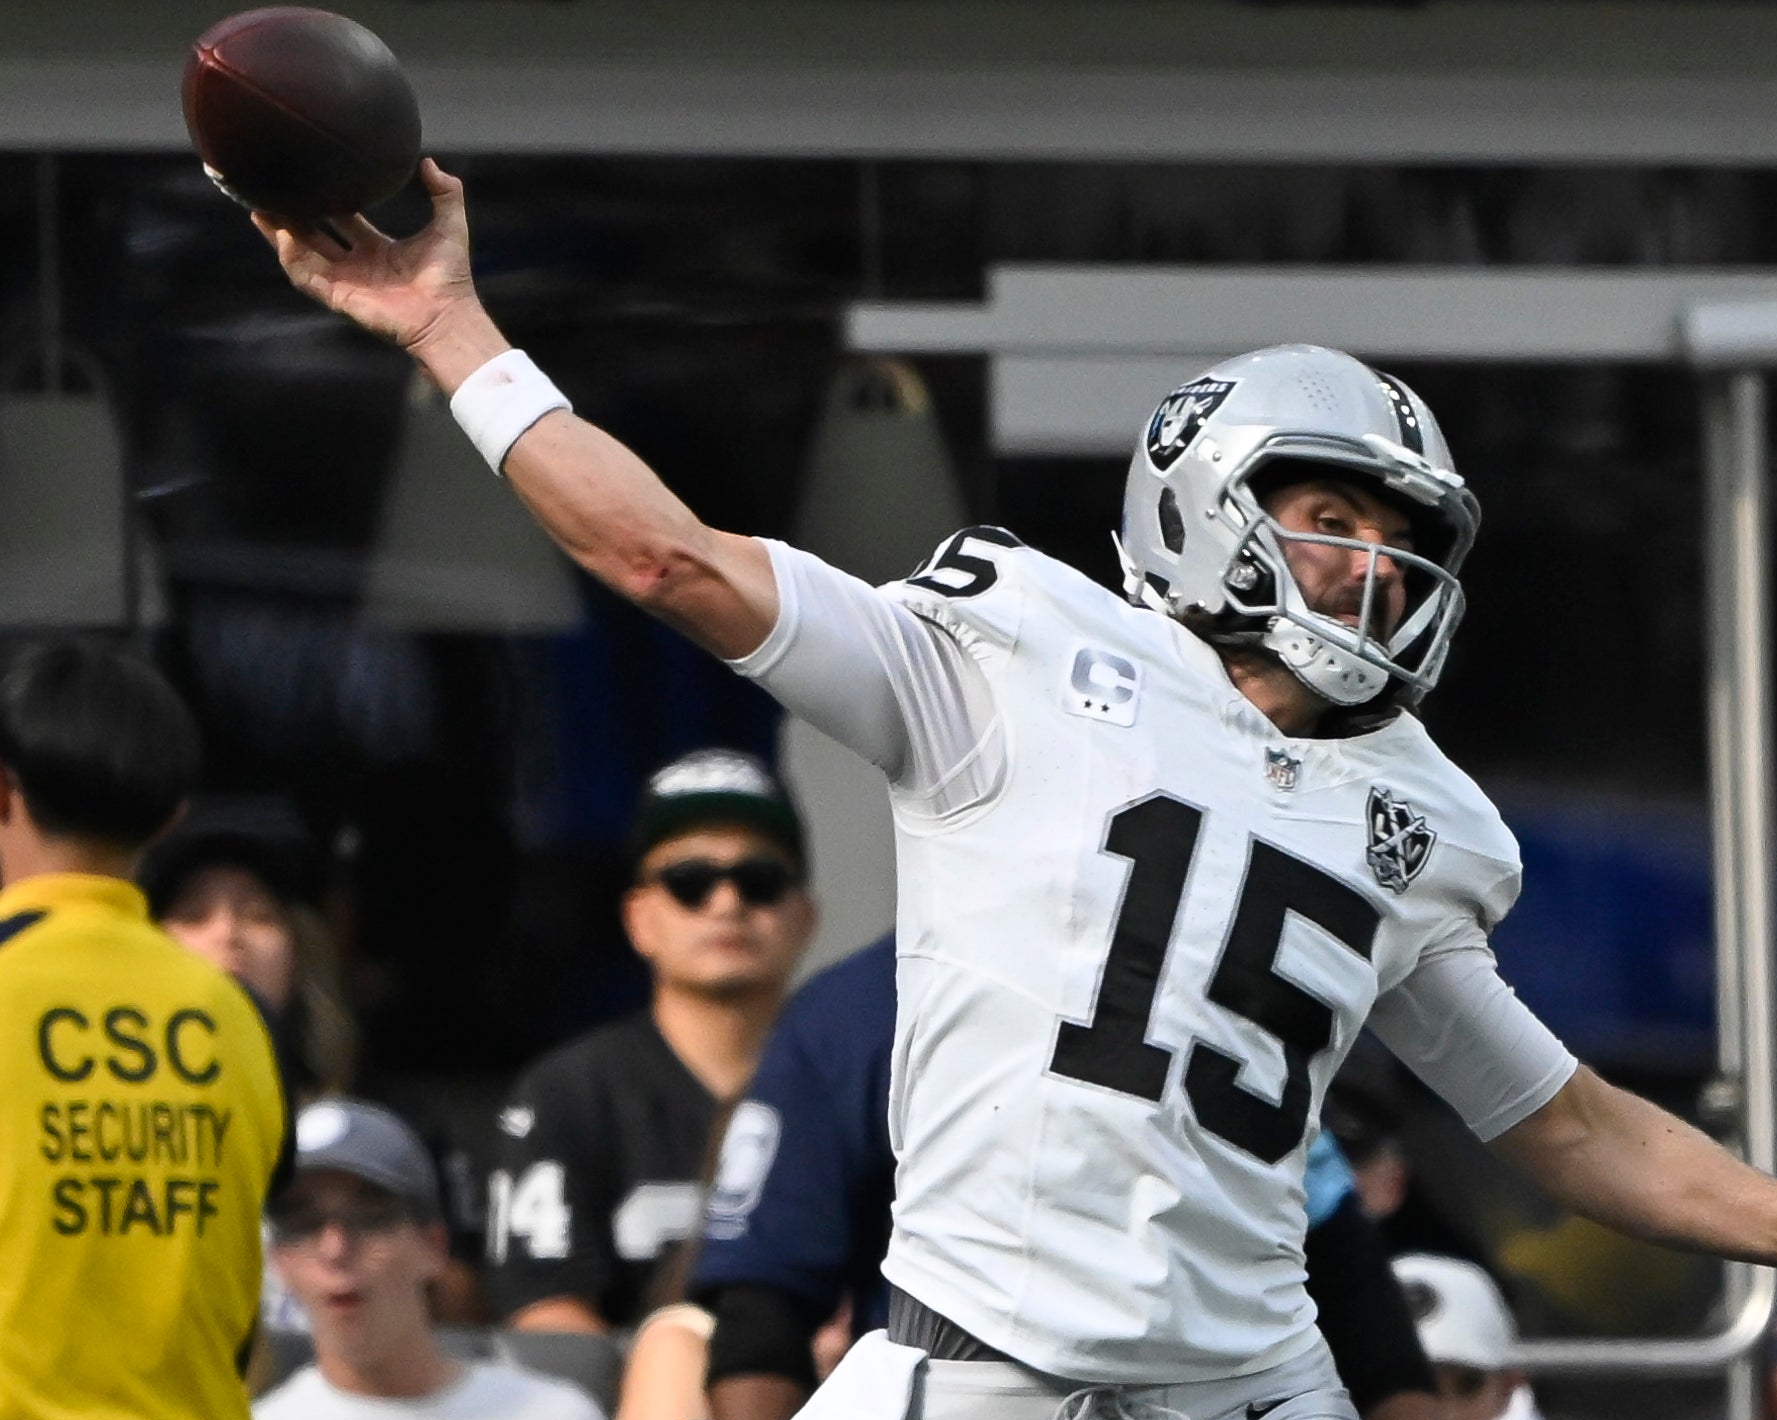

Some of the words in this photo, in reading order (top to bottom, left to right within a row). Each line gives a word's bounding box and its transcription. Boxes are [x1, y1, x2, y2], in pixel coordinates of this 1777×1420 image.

[904, 525, 1025, 599] 5
[1070, 648, 1137, 704] C
[1041, 788, 1386, 1167] 15
[38, 1007, 221, 1084] CSC
[40, 1102, 231, 1166] SECURITY
[53, 1177, 220, 1237] STAFF
